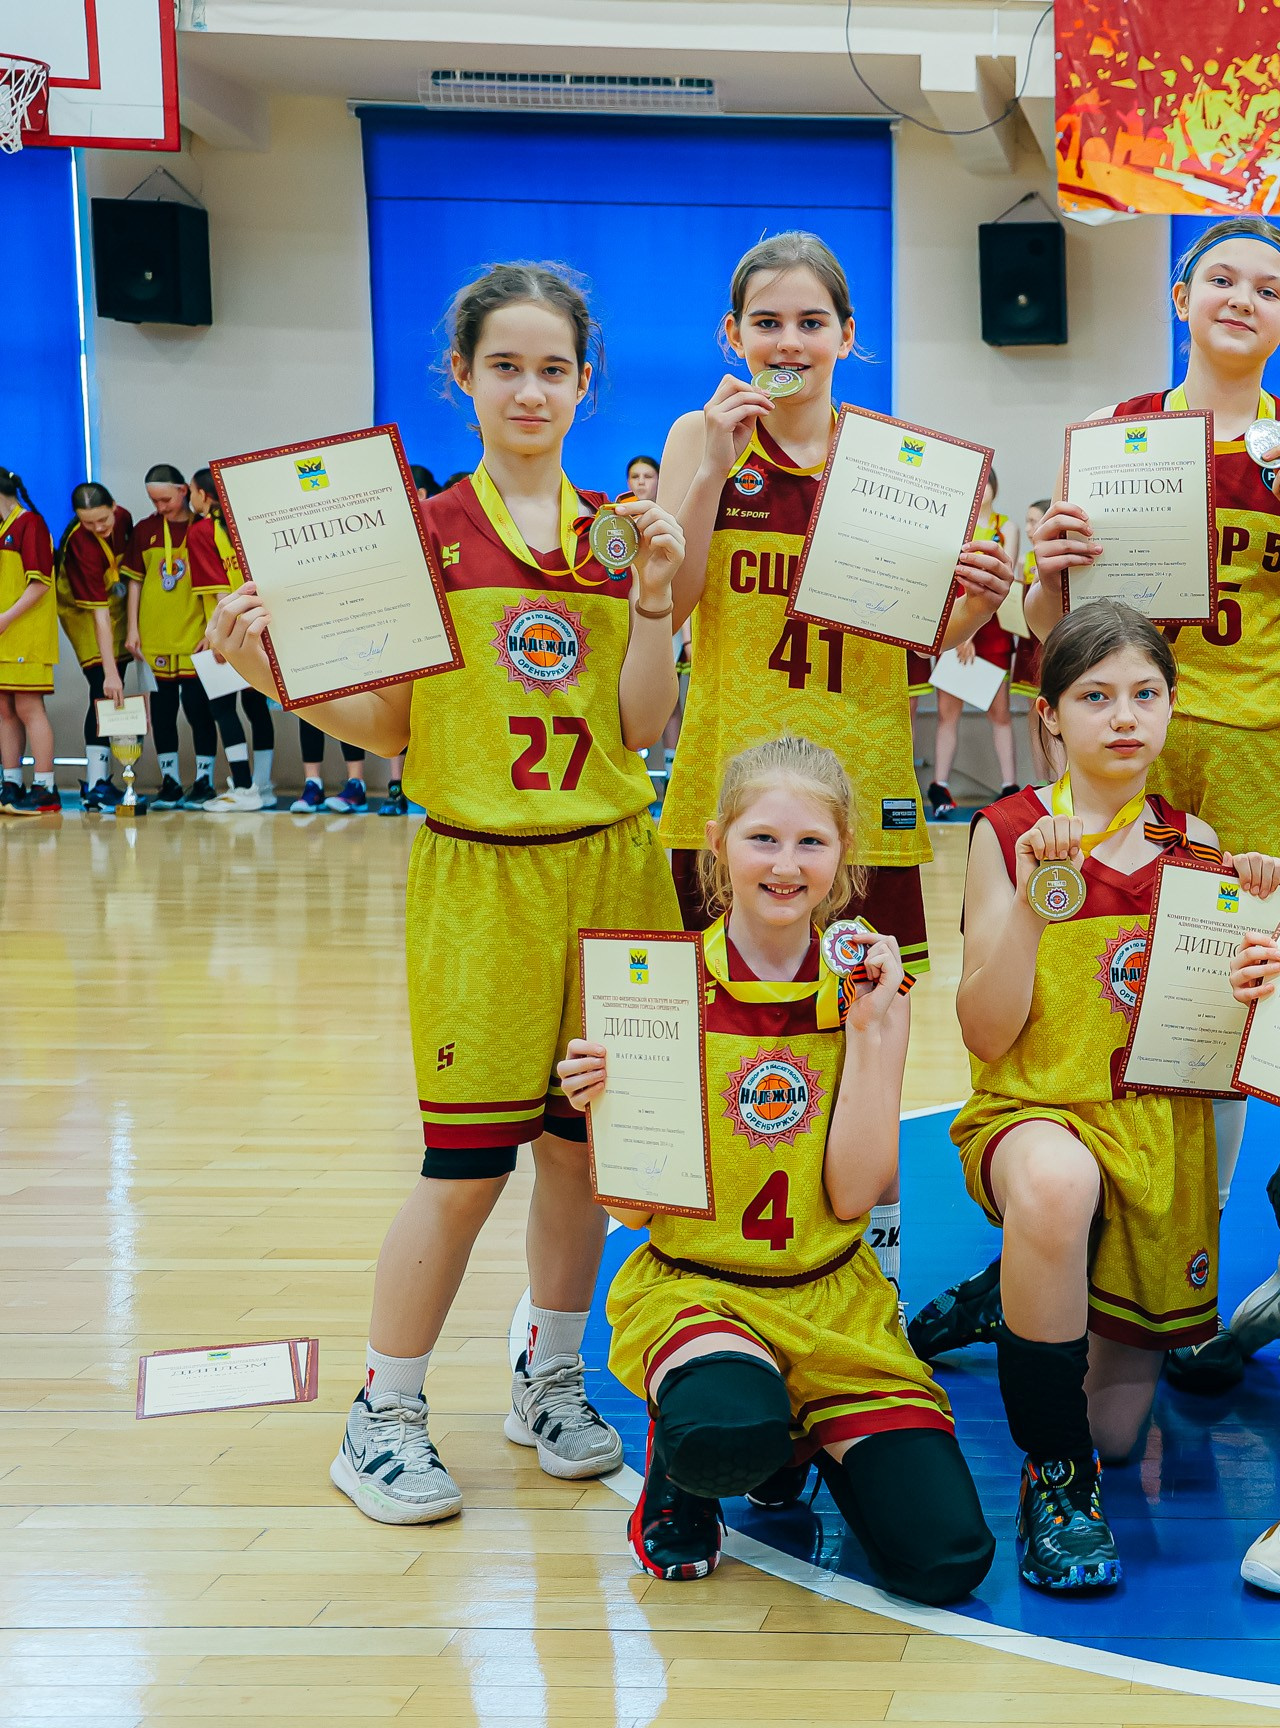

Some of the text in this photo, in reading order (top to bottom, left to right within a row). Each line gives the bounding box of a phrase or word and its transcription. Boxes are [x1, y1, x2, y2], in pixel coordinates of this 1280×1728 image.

[851, 477, 948, 517] ДИПЛОМ
[1090, 478, 1183, 498] ДИПЛОМ
[741, 510, 770, 519] SPORT
[862, 506, 929, 530] НАГРАЖДАЕТСЯ
[272, 508, 386, 552] ДИПЛОМ
[297, 543, 378, 566] НАГРАЖДАЕТСЯ
[509, 636, 576, 657] НАДЕЖДА
[768, 619, 844, 693] 41
[508, 716, 593, 791] 27
[1052, 869, 1058, 880] 1
[1261, 928, 1274, 936] СПОР
[1174, 934, 1240, 958] ДИПЛ
[604, 1017, 679, 1039] ДИПЛОМ
[616, 1052, 669, 1062] НАГРАЖДАЕТСЯ
[740, 1086, 806, 1105] НАДЕЖДА
[746, 1109, 799, 1130] ОРЕНБУРЖЬЕ
[741, 1170, 794, 1250] 4
